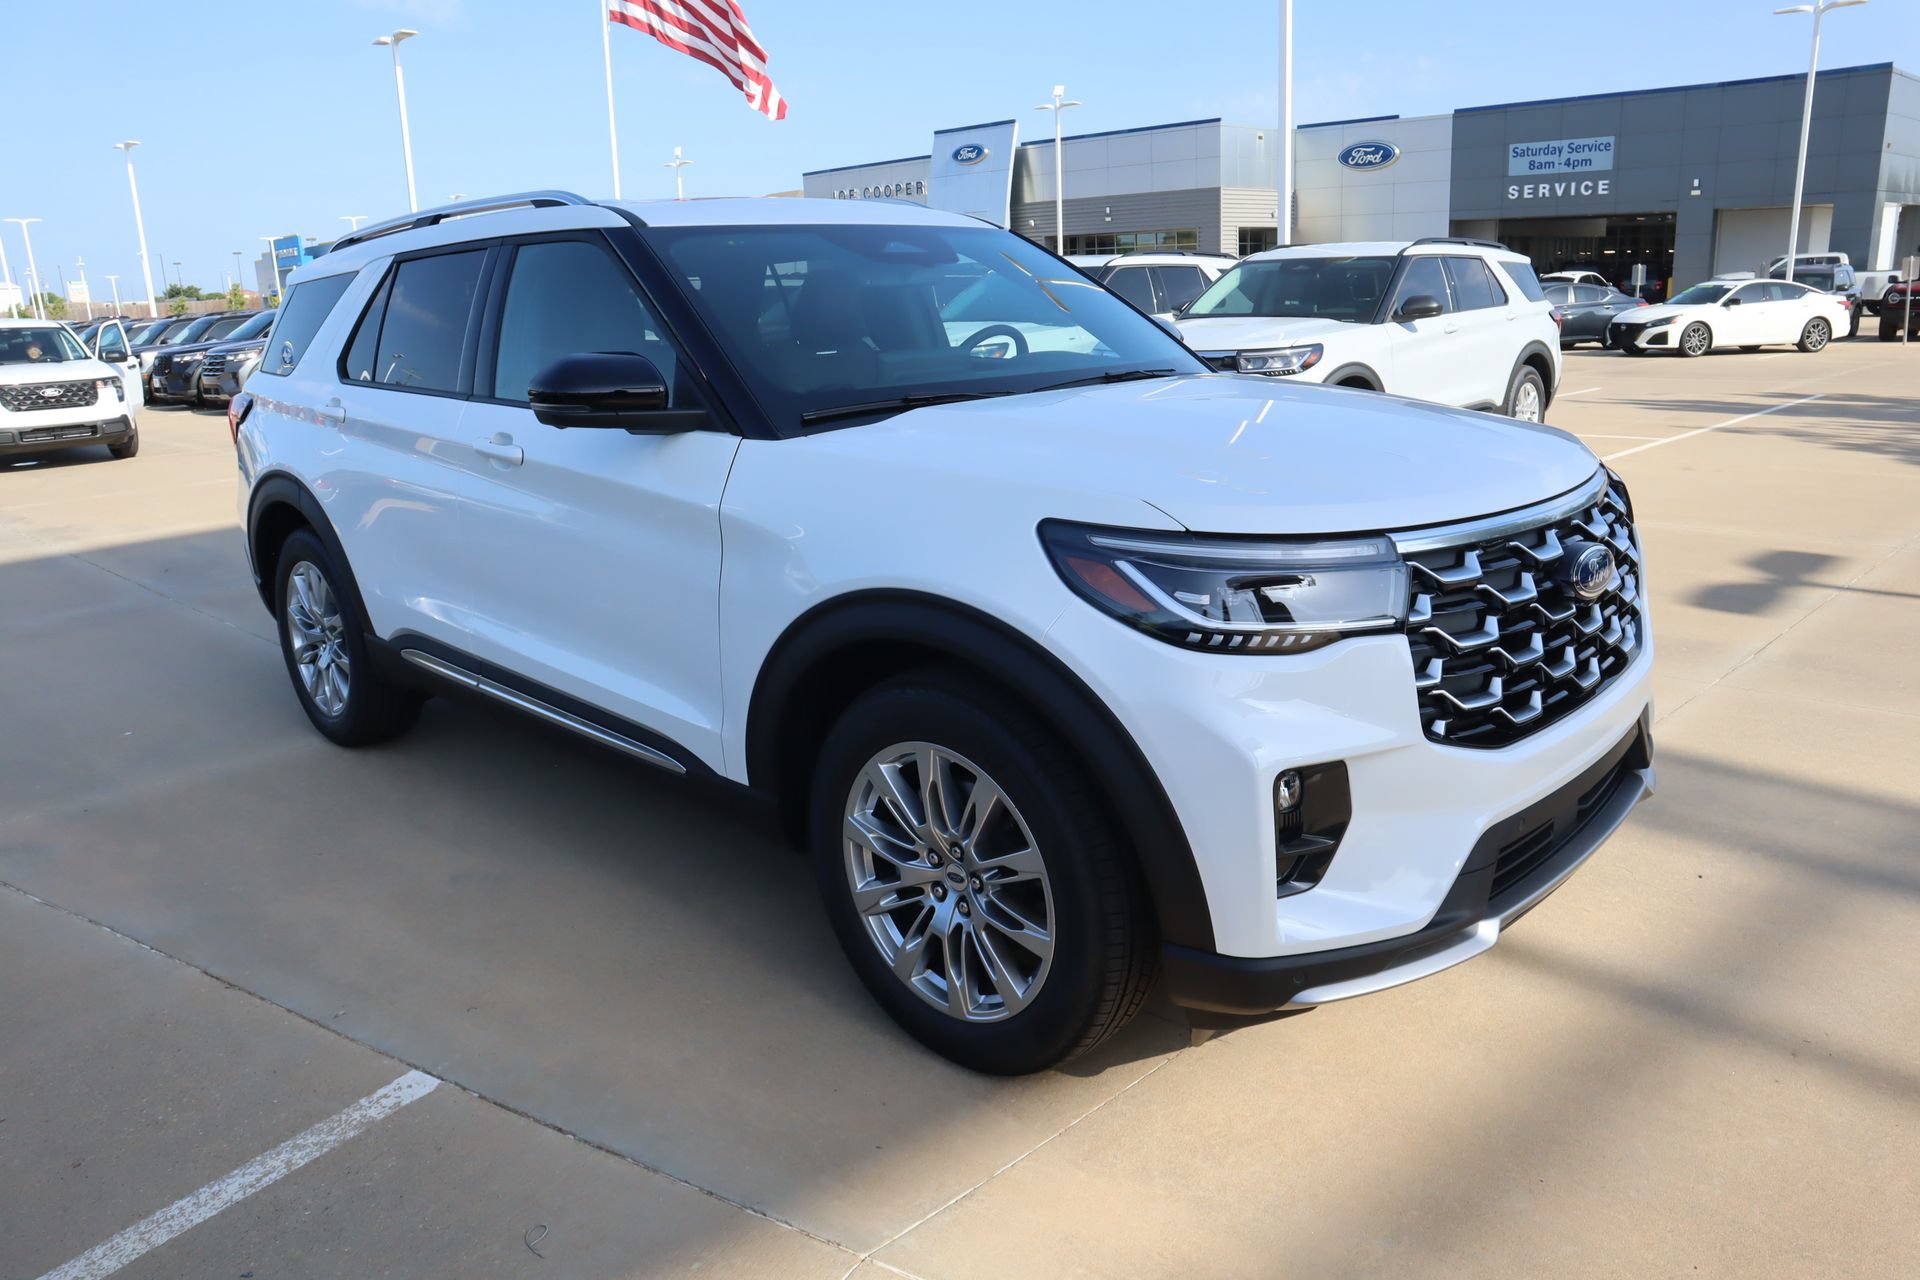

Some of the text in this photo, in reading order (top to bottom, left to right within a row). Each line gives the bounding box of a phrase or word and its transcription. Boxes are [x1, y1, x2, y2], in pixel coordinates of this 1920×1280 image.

[957, 147, 978, 160] Ford
[1348, 147, 1384, 165] Ford
[1512, 140, 1612, 158] Saturday Service
[1528, 160, 1555, 170] 8am
[1564, 157, 1592, 169] 4pm
[863, 181, 925, 199] COOPER
[1507, 180, 1610, 199] SERVICE
[1588, 556, 1610, 587] Ford
